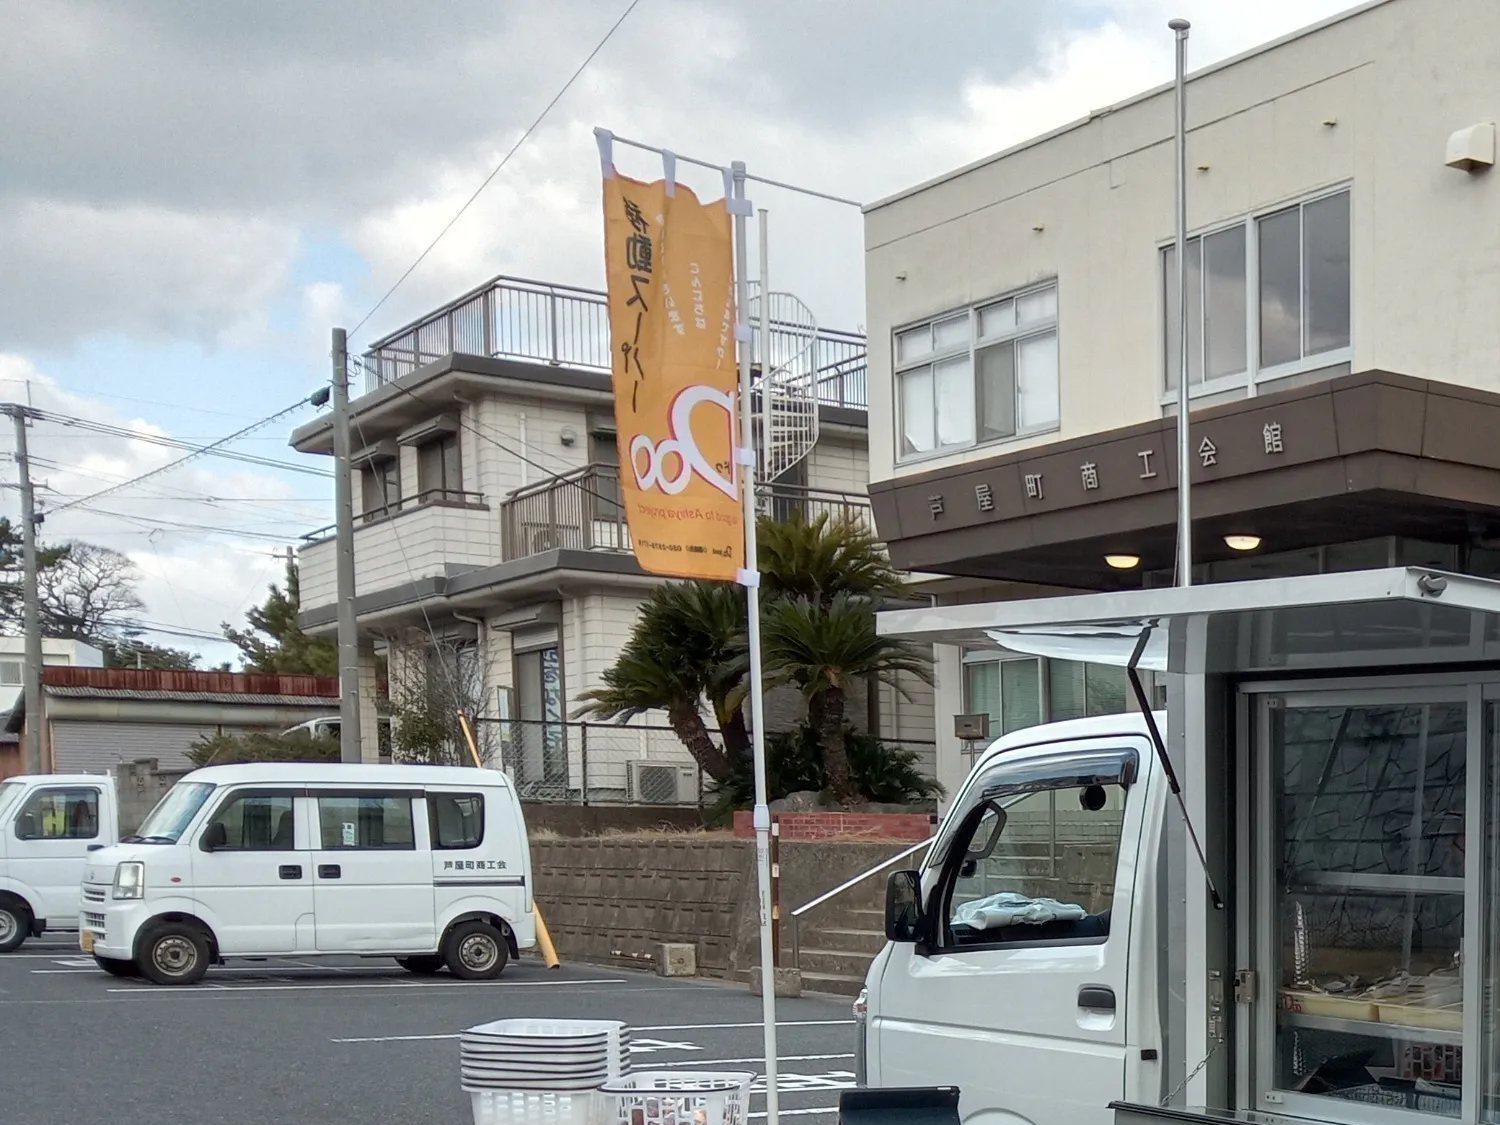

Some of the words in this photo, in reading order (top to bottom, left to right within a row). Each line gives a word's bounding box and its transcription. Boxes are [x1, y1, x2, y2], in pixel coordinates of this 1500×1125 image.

[926, 421, 1284, 520] 芦屋町商工会館
[443, 860, 507, 870] 芦屋町商工会
